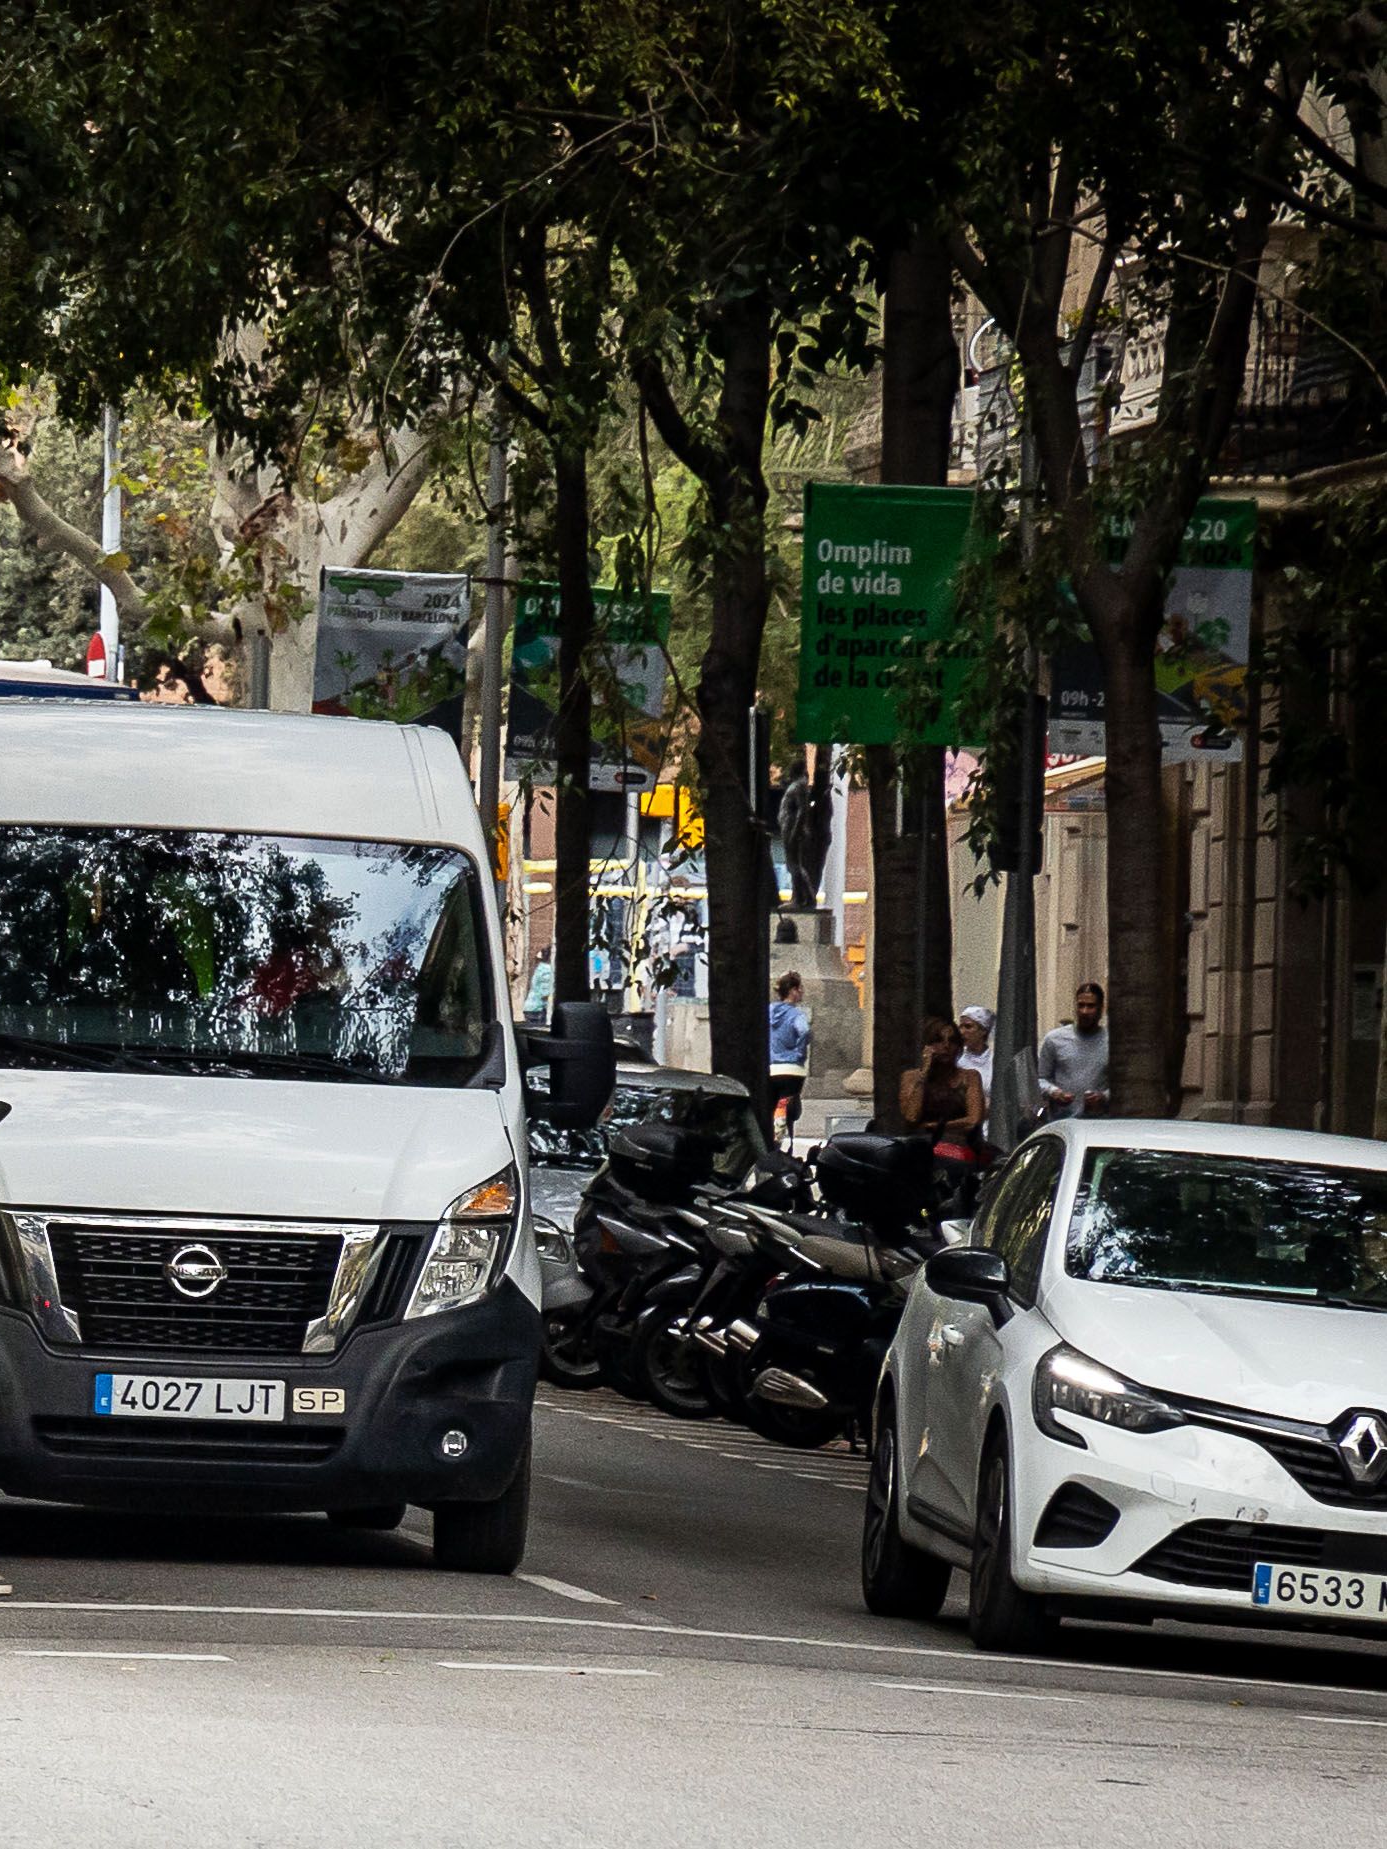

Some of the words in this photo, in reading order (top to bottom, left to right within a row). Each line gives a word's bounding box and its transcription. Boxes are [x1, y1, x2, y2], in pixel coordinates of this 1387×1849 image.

[1199, 519, 1229, 542] 20
[817, 538, 912, 570] Omplim
[816, 569, 845, 595] de
[851, 570, 902, 596] vida
[423, 592, 461, 608] 2024
[817, 600, 847, 625] les
[853, 601, 928, 631] places
[815, 632, 978, 664] d'aparcaen
[814, 664, 843, 688] de
[849, 664, 869, 688] la
[875, 668, 944, 689] ciat
[1061, 689, 1089, 707] 09h
[167, 1264, 225, 1281] NISSAN
[120, 1379, 203, 1412] 4027
[215, 1383, 277, 1415] LJT
[298, 1390, 340, 1410] SP
[1277, 1571, 1365, 1610] 6533
